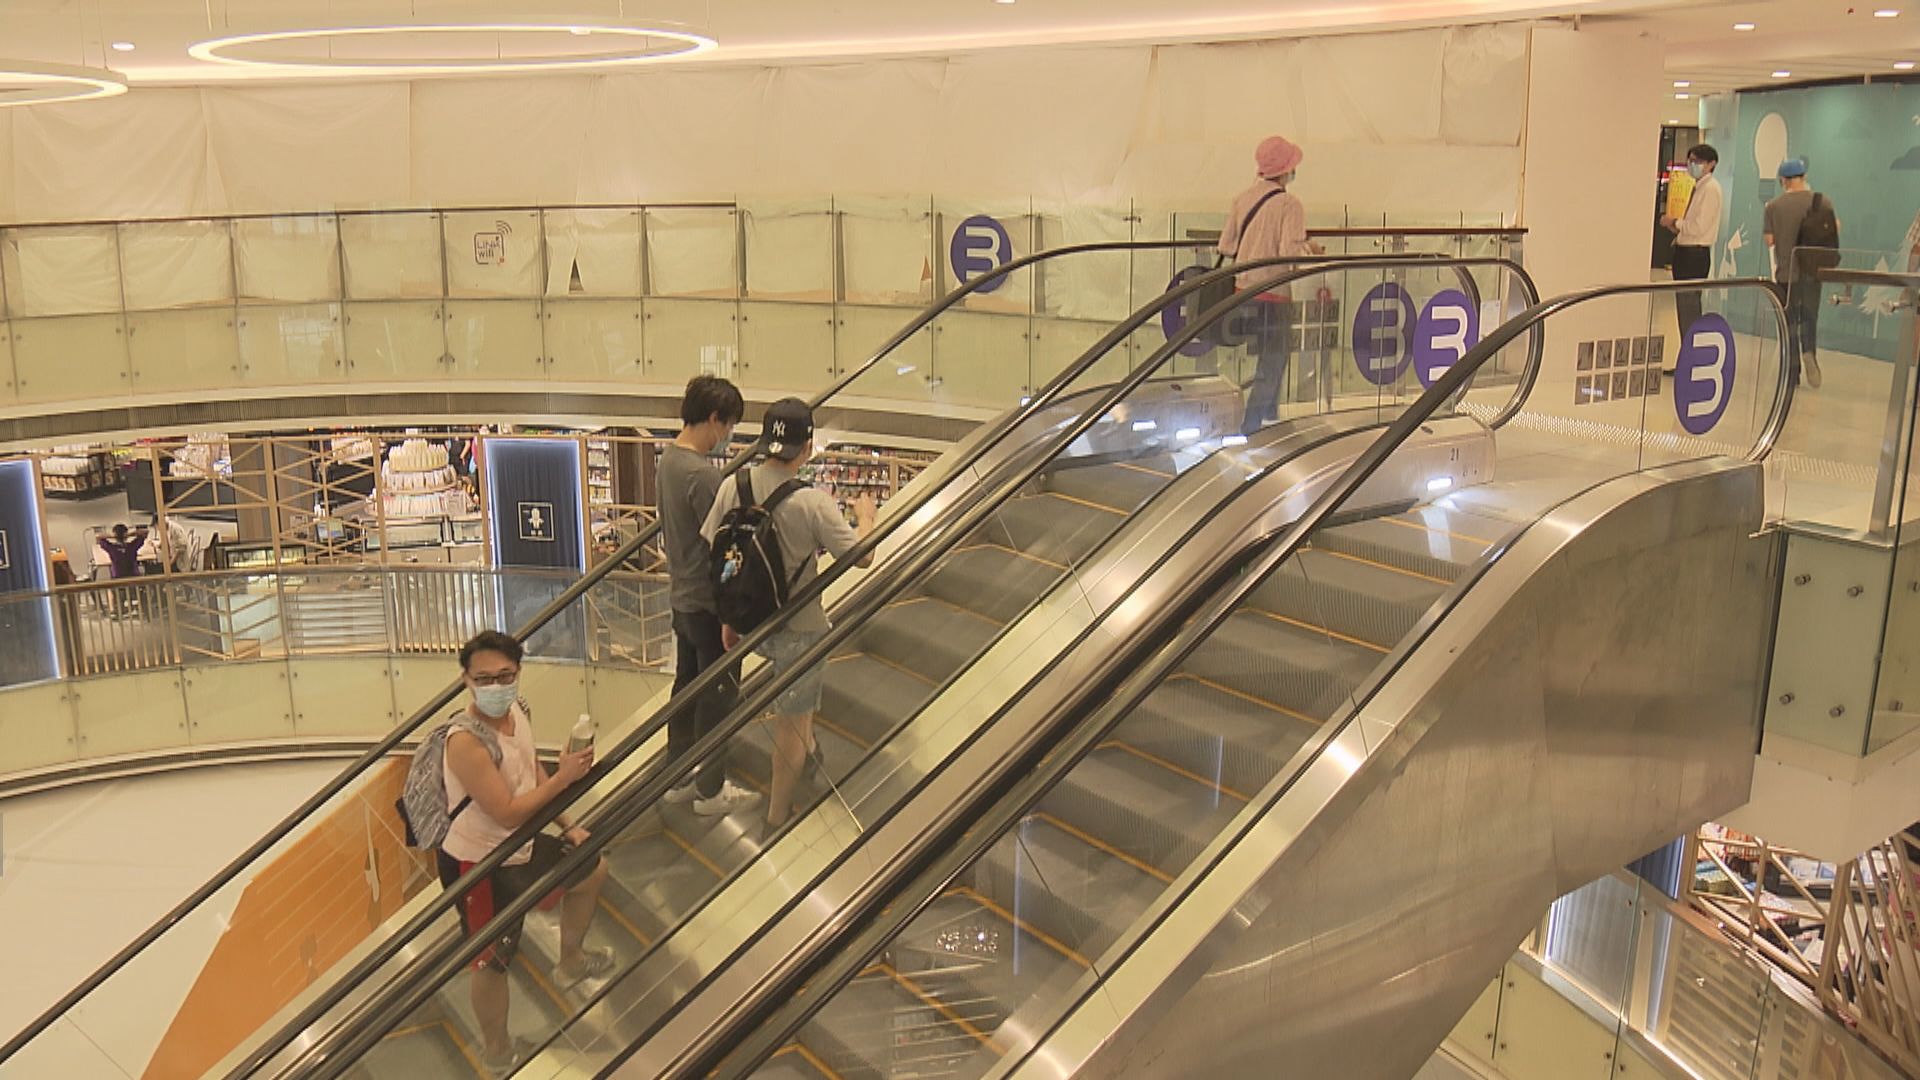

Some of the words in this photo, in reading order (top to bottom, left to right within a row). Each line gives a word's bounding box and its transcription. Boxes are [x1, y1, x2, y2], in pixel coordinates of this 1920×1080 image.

[965, 226, 1000, 281] 3
[1369, 298, 1406, 370] 3
[1428, 305, 1468, 381] 3
[1687, 332, 1726, 417] 3
